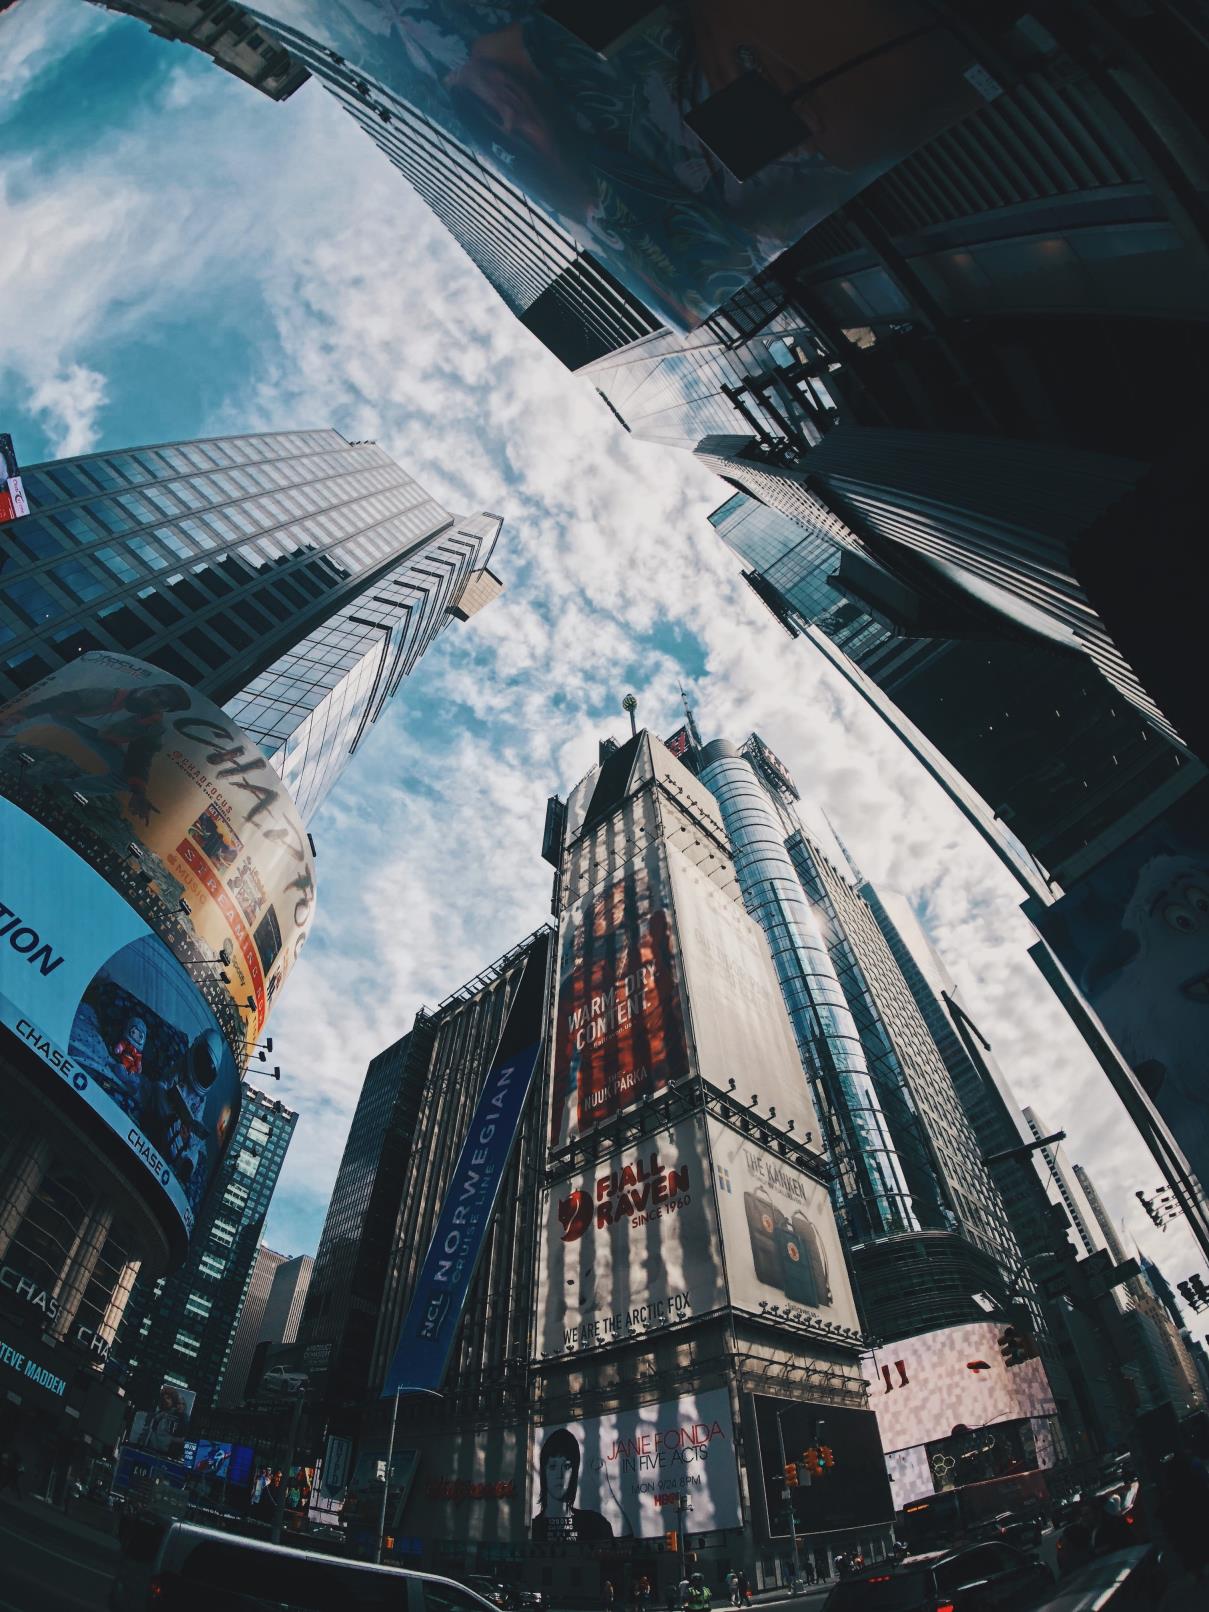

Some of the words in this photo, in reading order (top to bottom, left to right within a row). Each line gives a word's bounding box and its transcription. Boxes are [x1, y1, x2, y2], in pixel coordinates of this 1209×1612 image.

[213, 800, 231, 822] WORLD
[184, 848, 258, 977] STREAMING
[15, 1019, 74, 1079] CHASE
[584, 1087, 611, 1112] NUUK
[614, 1064, 648, 1093] PARKA
[127, 1128, 164, 1178] CHASE
[434, 1067, 515, 1282] NORWEGIAN
[743, 1148, 766, 1176] THE
[452, 1214, 479, 1284] CRUISE
[478, 1163, 494, 1205] LINE
[632, 1205, 662, 1229] SINCE
[664, 1195, 691, 1215] 1960
[422, 1294, 444, 1338] NCL
[563, 1326, 577, 1346] WE
[581, 1320, 600, 1341] ARE
[603, 1314, 622, 1334] THE
[625, 1299, 664, 1328] ARCTIC
[668, 1291, 691, 1312] FOX
[24, 1359, 67, 1397] MADDEN
[607, 1433, 651, 1461] JANE
[655, 1421, 725, 1452] FONDA
[622, 1456, 635, 1473] IN
[640, 1452, 667, 1472] FIVE
[671, 1444, 708, 1463] ACTS
[632, 1481, 655, 1495] MON
[657, 1479, 677, 1492] 9/24
[679, 1474, 701, 1488] 8PM
